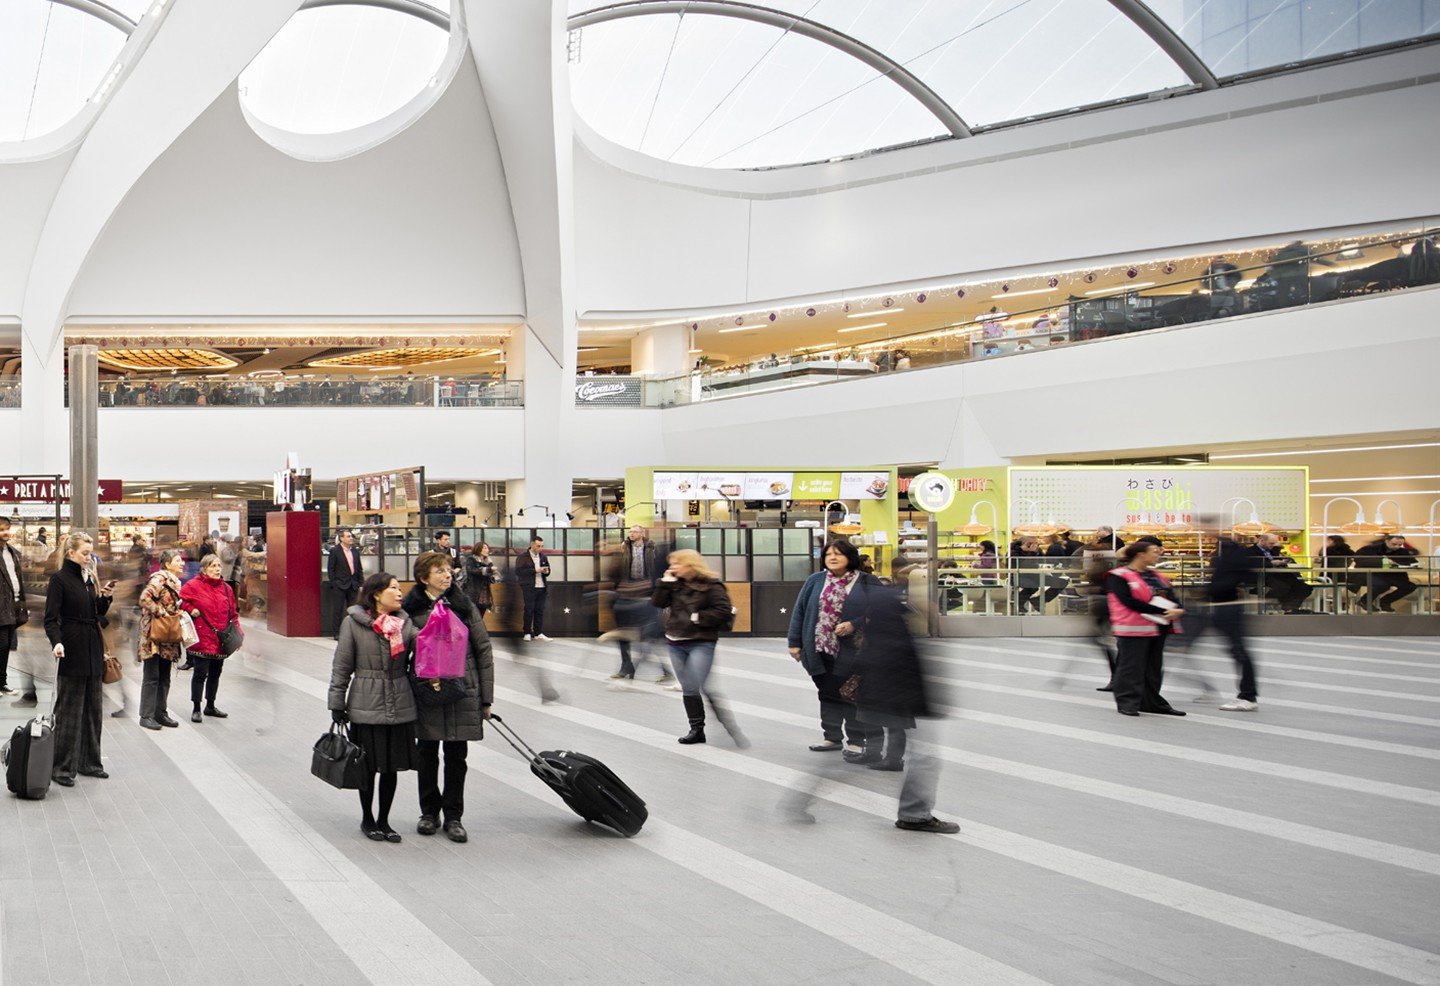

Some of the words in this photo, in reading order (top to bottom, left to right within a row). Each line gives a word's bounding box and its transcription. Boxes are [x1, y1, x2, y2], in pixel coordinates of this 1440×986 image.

[14, 483, 38, 498] PRET
[40, 483, 48, 498] A
[1126, 482, 1192, 511] wasabi
[1126, 514, 1152, 523] susi
[1165, 512, 1192, 523] beto
